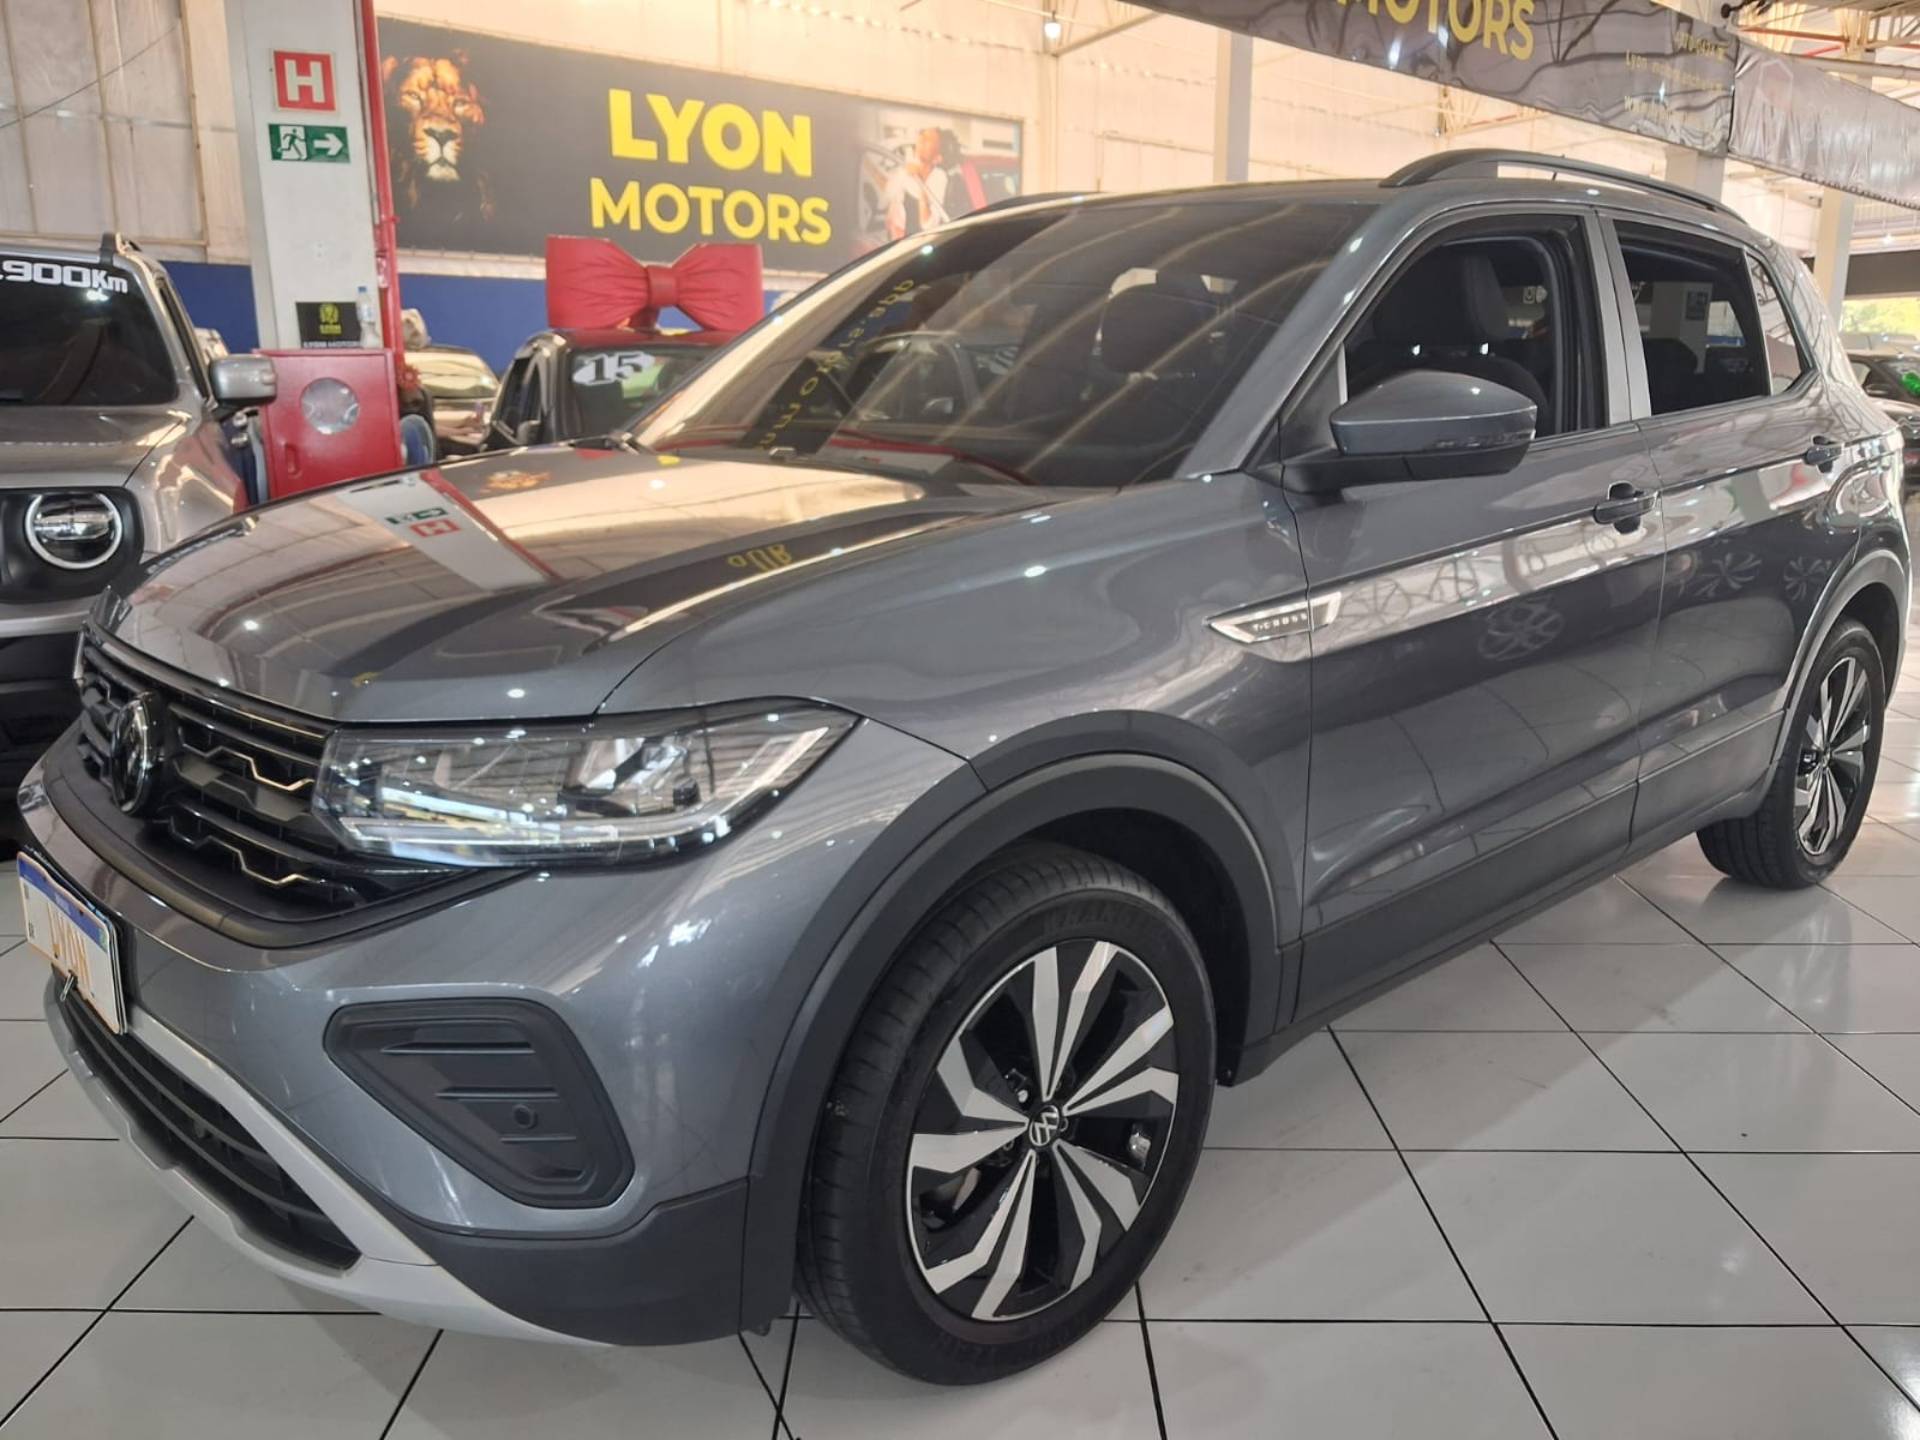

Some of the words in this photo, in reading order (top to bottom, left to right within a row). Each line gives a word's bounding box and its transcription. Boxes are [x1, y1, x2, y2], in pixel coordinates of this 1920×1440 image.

[284, 59, 325, 103] H
[608, 88, 812, 177] LYON
[590, 177, 832, 245] MOTORS
[587, 352, 645, 384] 15
